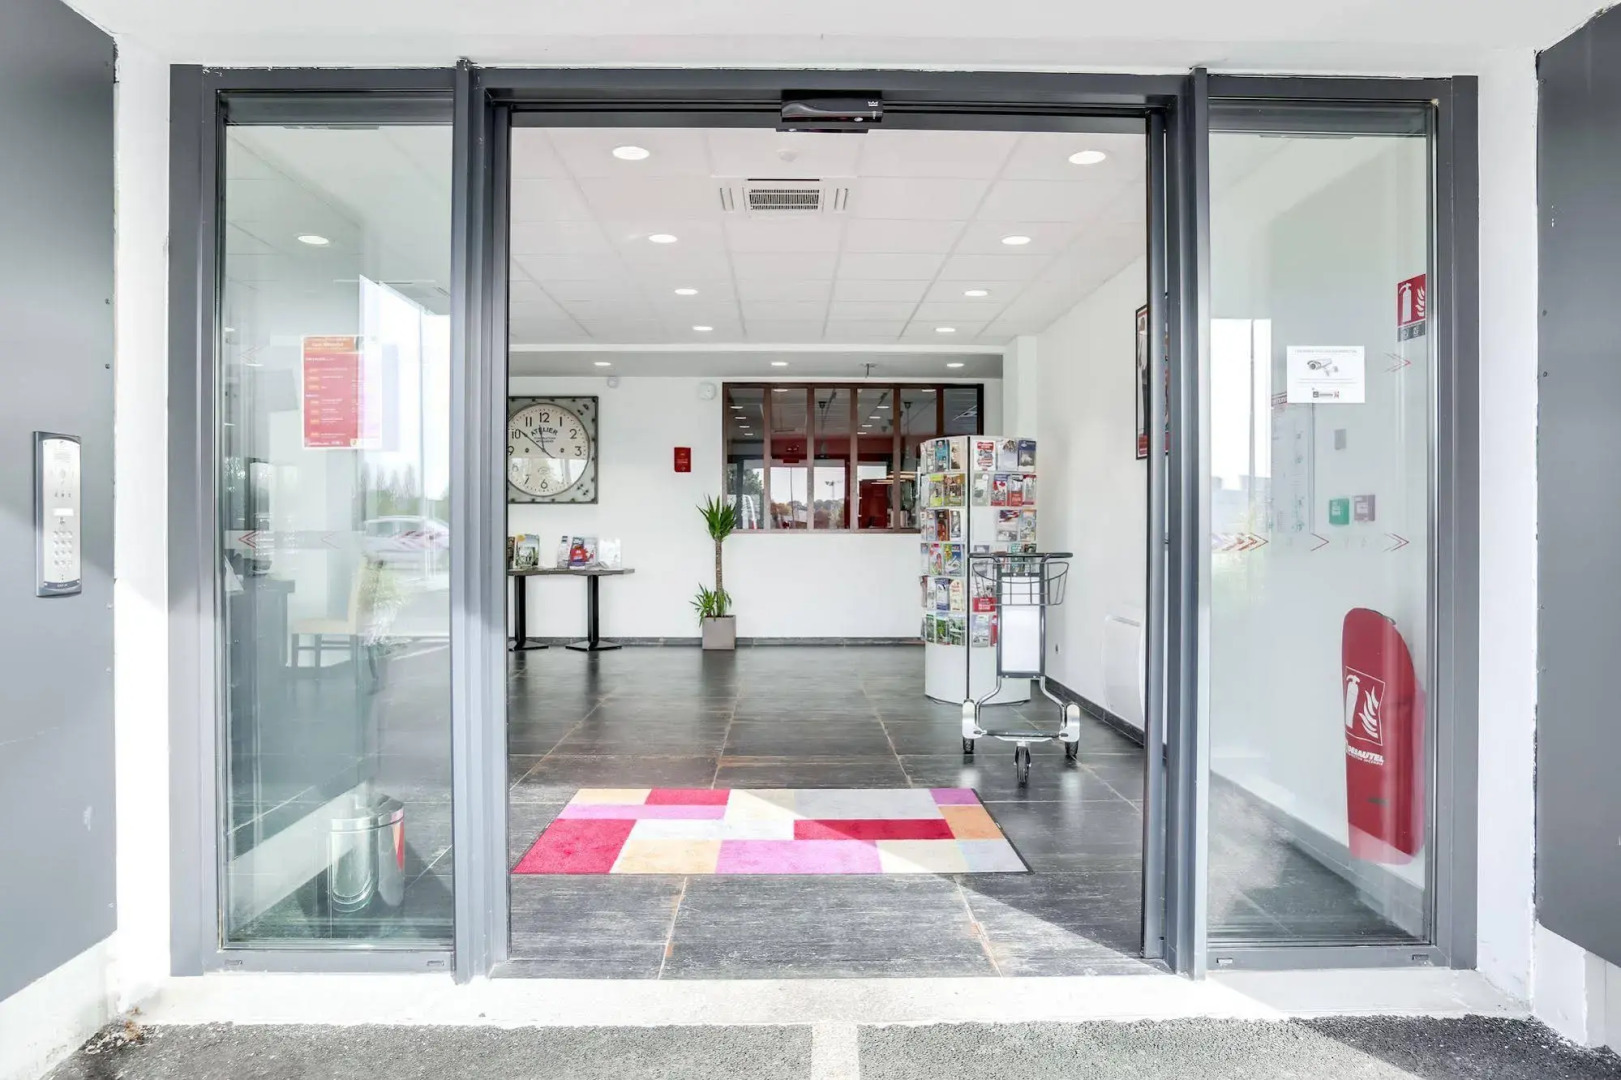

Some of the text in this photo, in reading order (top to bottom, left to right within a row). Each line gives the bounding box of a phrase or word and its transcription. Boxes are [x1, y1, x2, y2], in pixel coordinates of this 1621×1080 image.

[526, 416, 532, 427] 11
[540, 412, 550, 422] 12
[560, 416, 562, 427] 1
[511, 429, 520, 439] 10
[570, 428, 578, 439] 2
[574, 446, 582, 456] 3
[540, 479, 548, 489] 6
